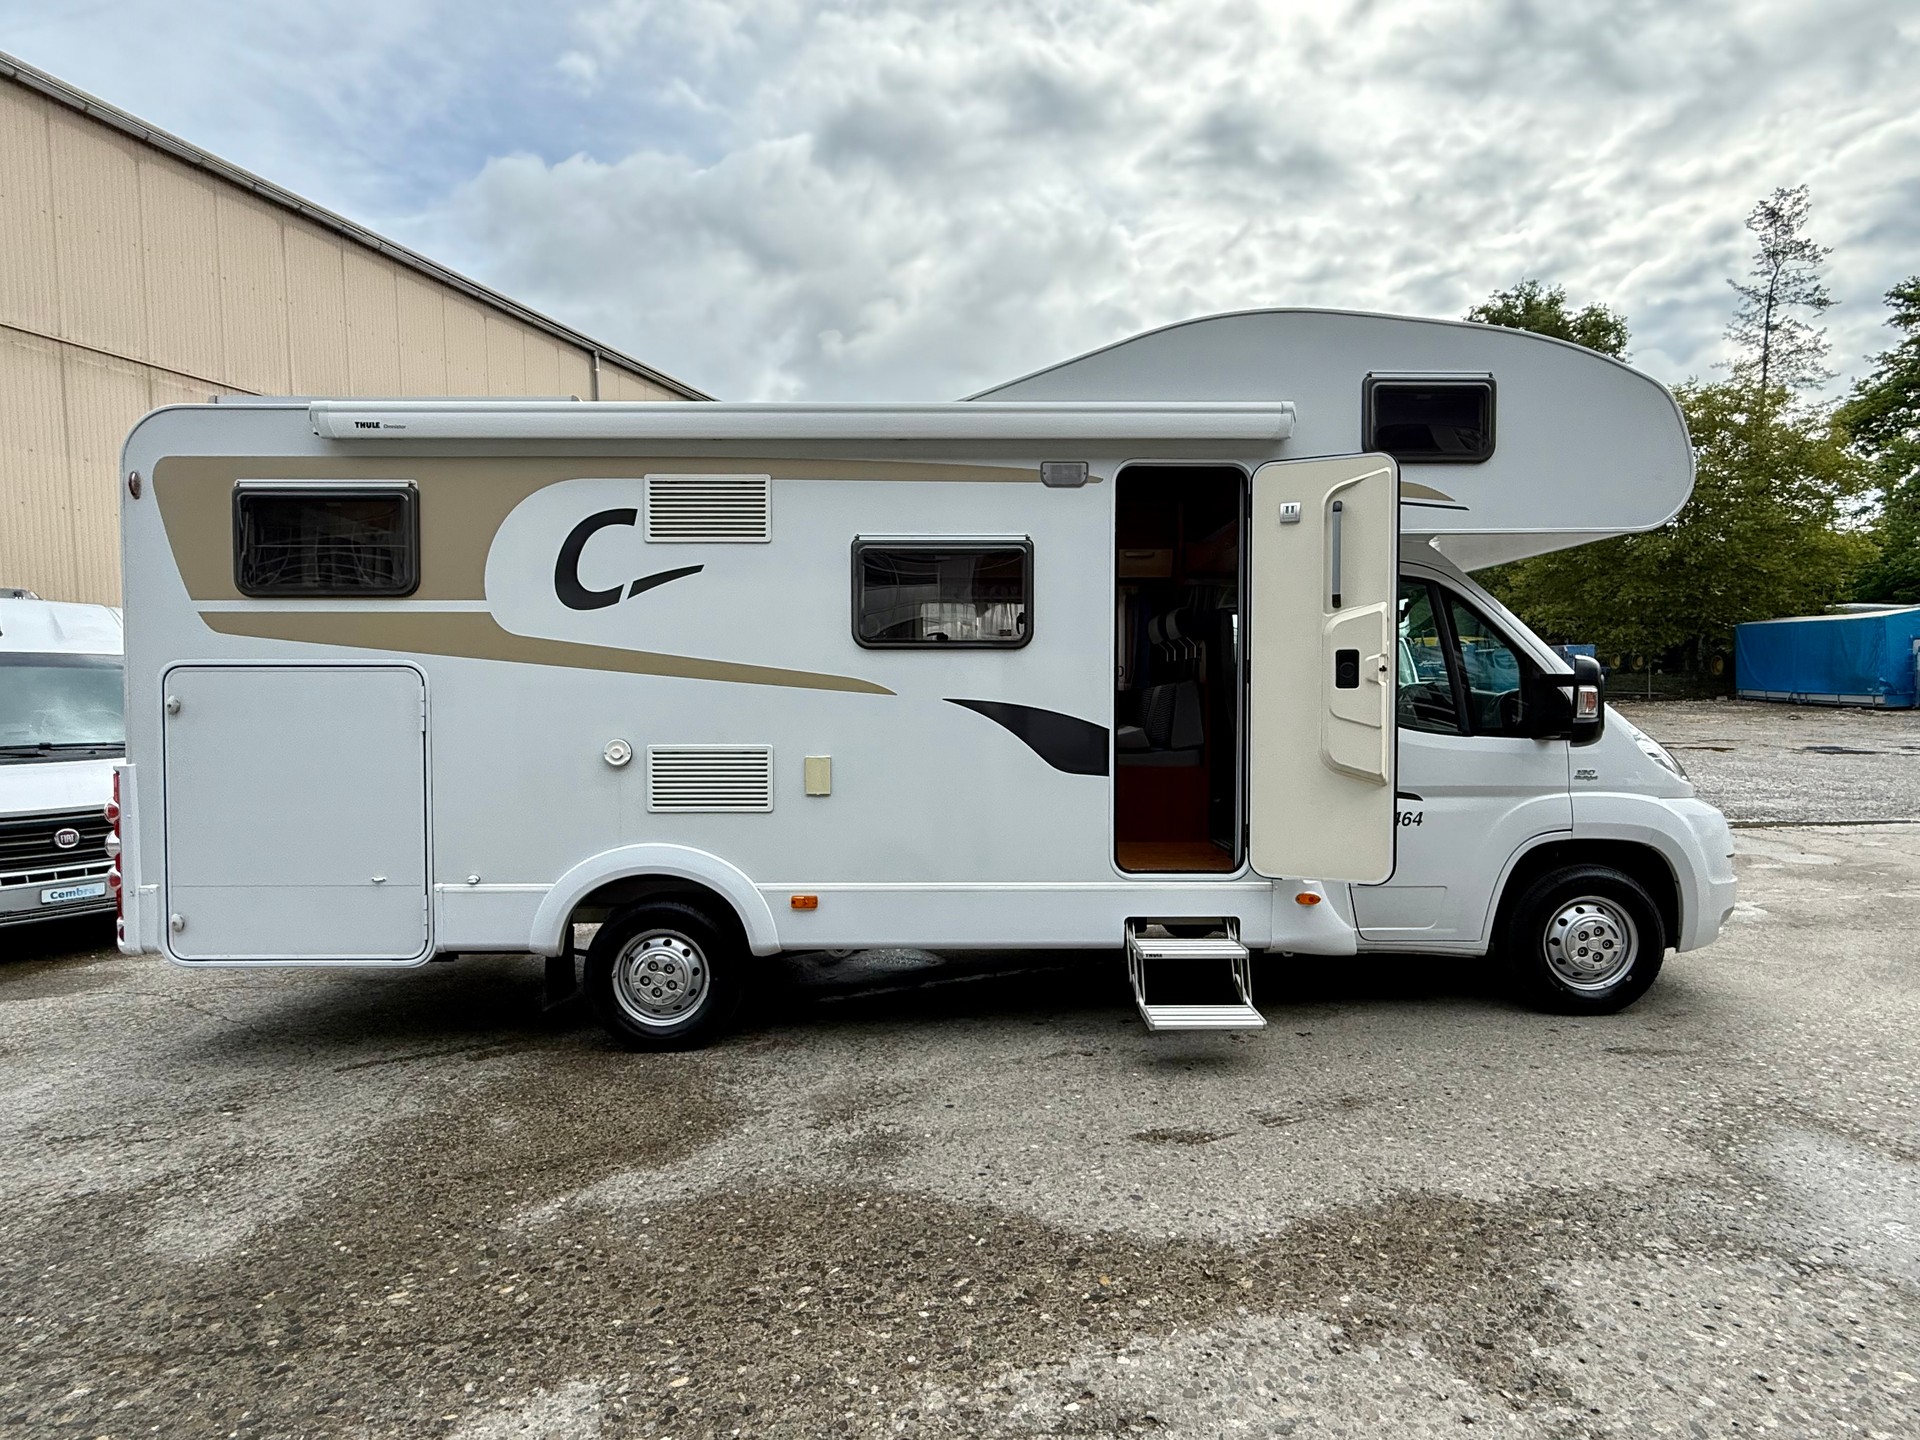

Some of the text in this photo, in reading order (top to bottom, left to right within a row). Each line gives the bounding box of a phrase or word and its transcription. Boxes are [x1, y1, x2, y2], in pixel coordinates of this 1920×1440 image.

[354, 421, 381, 429] THULE
[60, 833, 75, 844] FIAT
[50, 887, 96, 900] Cembra
